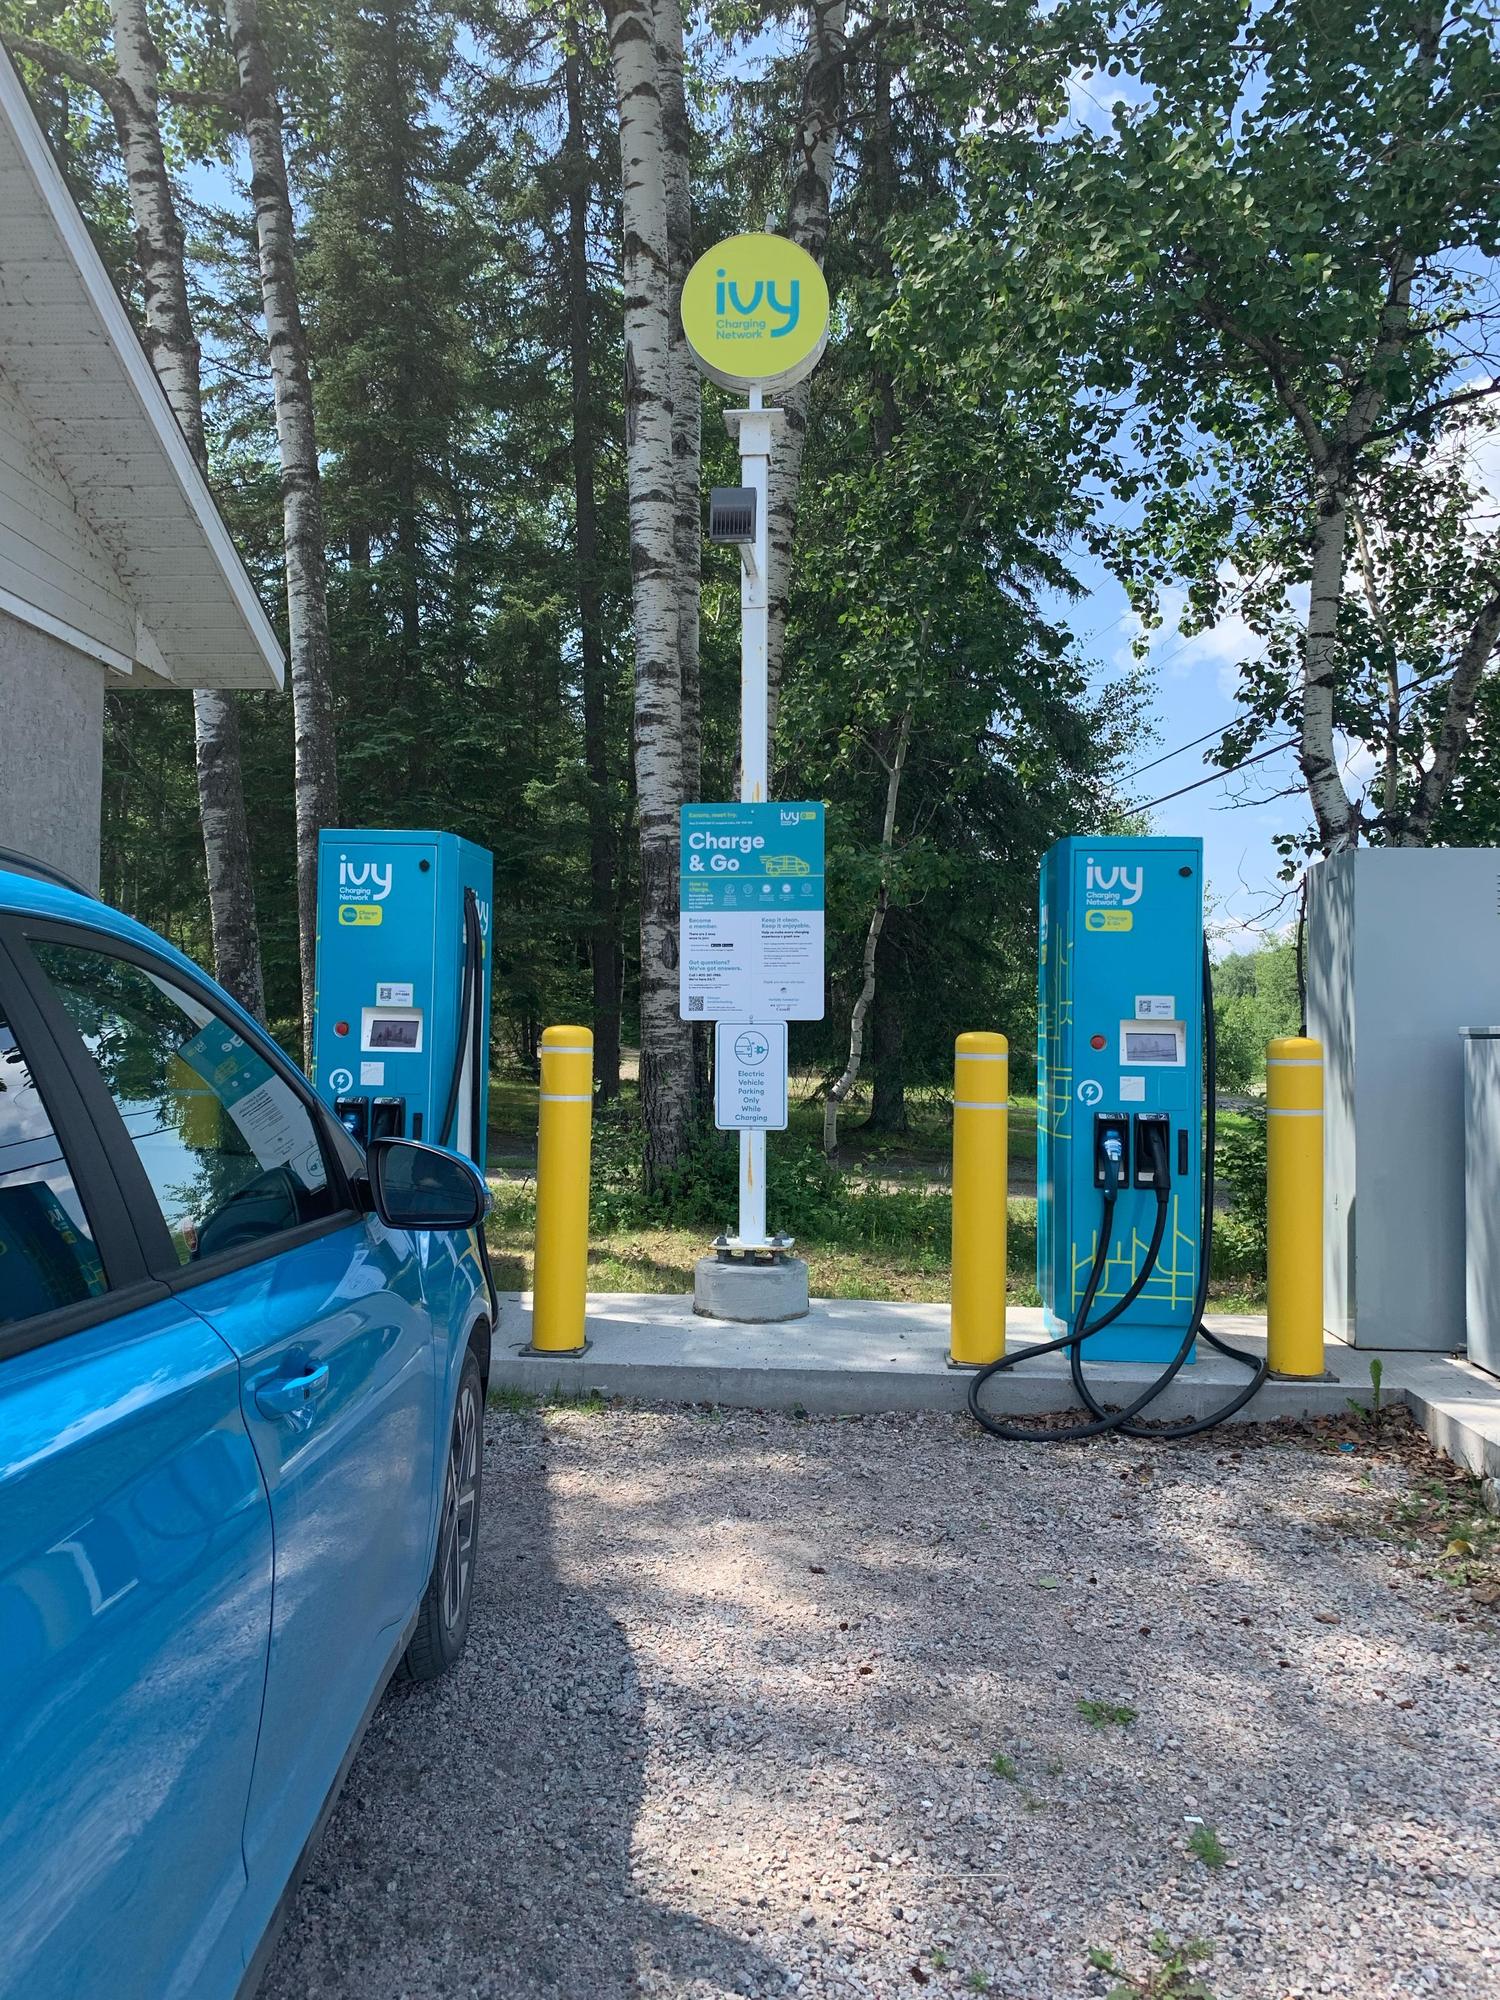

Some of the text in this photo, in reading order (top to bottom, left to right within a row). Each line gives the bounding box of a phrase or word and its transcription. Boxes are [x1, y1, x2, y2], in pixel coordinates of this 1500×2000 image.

[716, 268, 800, 338] ivy
[716, 319, 766, 330] Charging
[716, 330, 763, 340] Network
[780, 809, 800, 826] ivy
[688, 831, 765, 854] Charge
[689, 854, 740, 872] & Go
[339, 854, 392, 901] ivy
[1086, 857, 1143, 906] ivy
[339, 886, 371, 895] Charging
[1086, 891, 1120, 900] Charging
[738, 1088, 765, 1096] Parking
[735, 1114, 768, 1122] Charging
